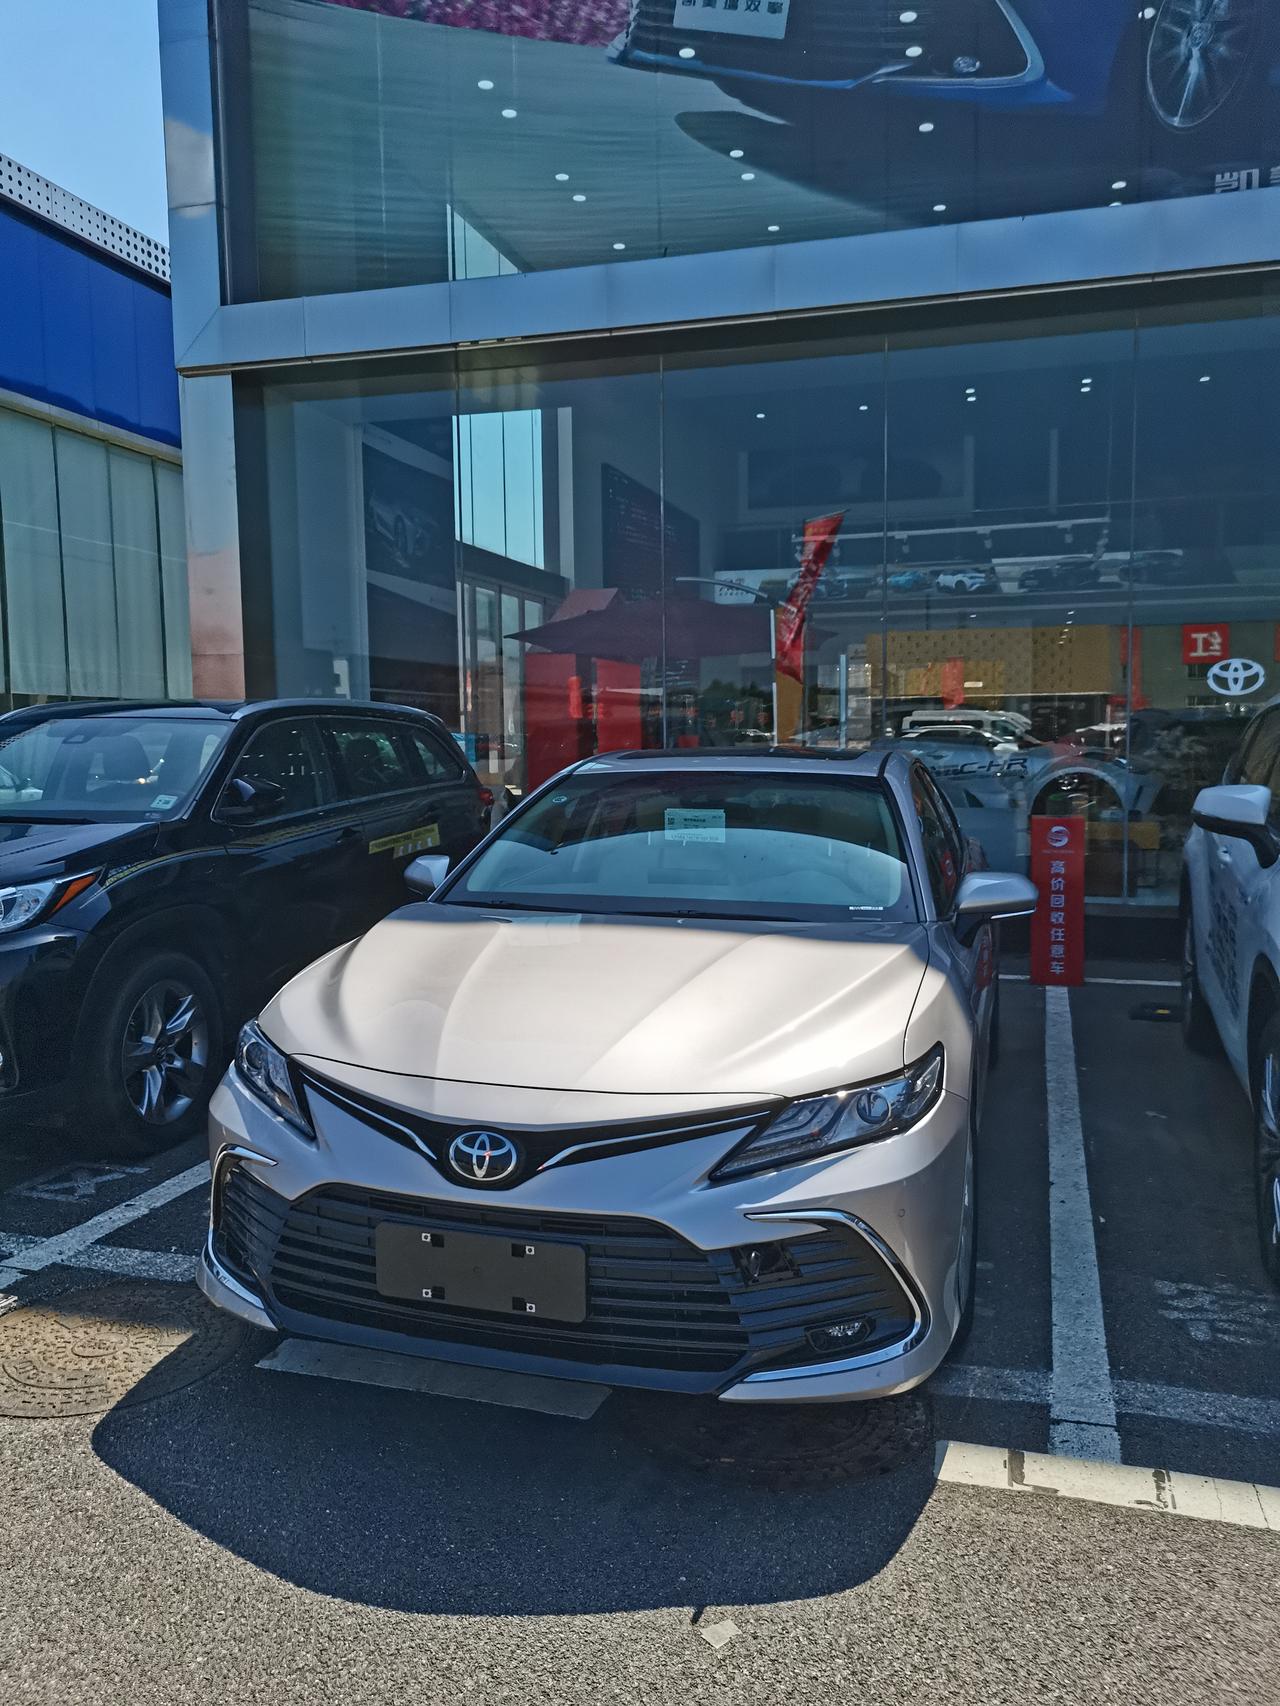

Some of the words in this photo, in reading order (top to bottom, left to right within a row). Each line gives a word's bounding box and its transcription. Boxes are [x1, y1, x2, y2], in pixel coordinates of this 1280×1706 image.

[1215, 165, 1280, 193] 凯
[1050, 860, 1065, 975] 高价回收任意车
